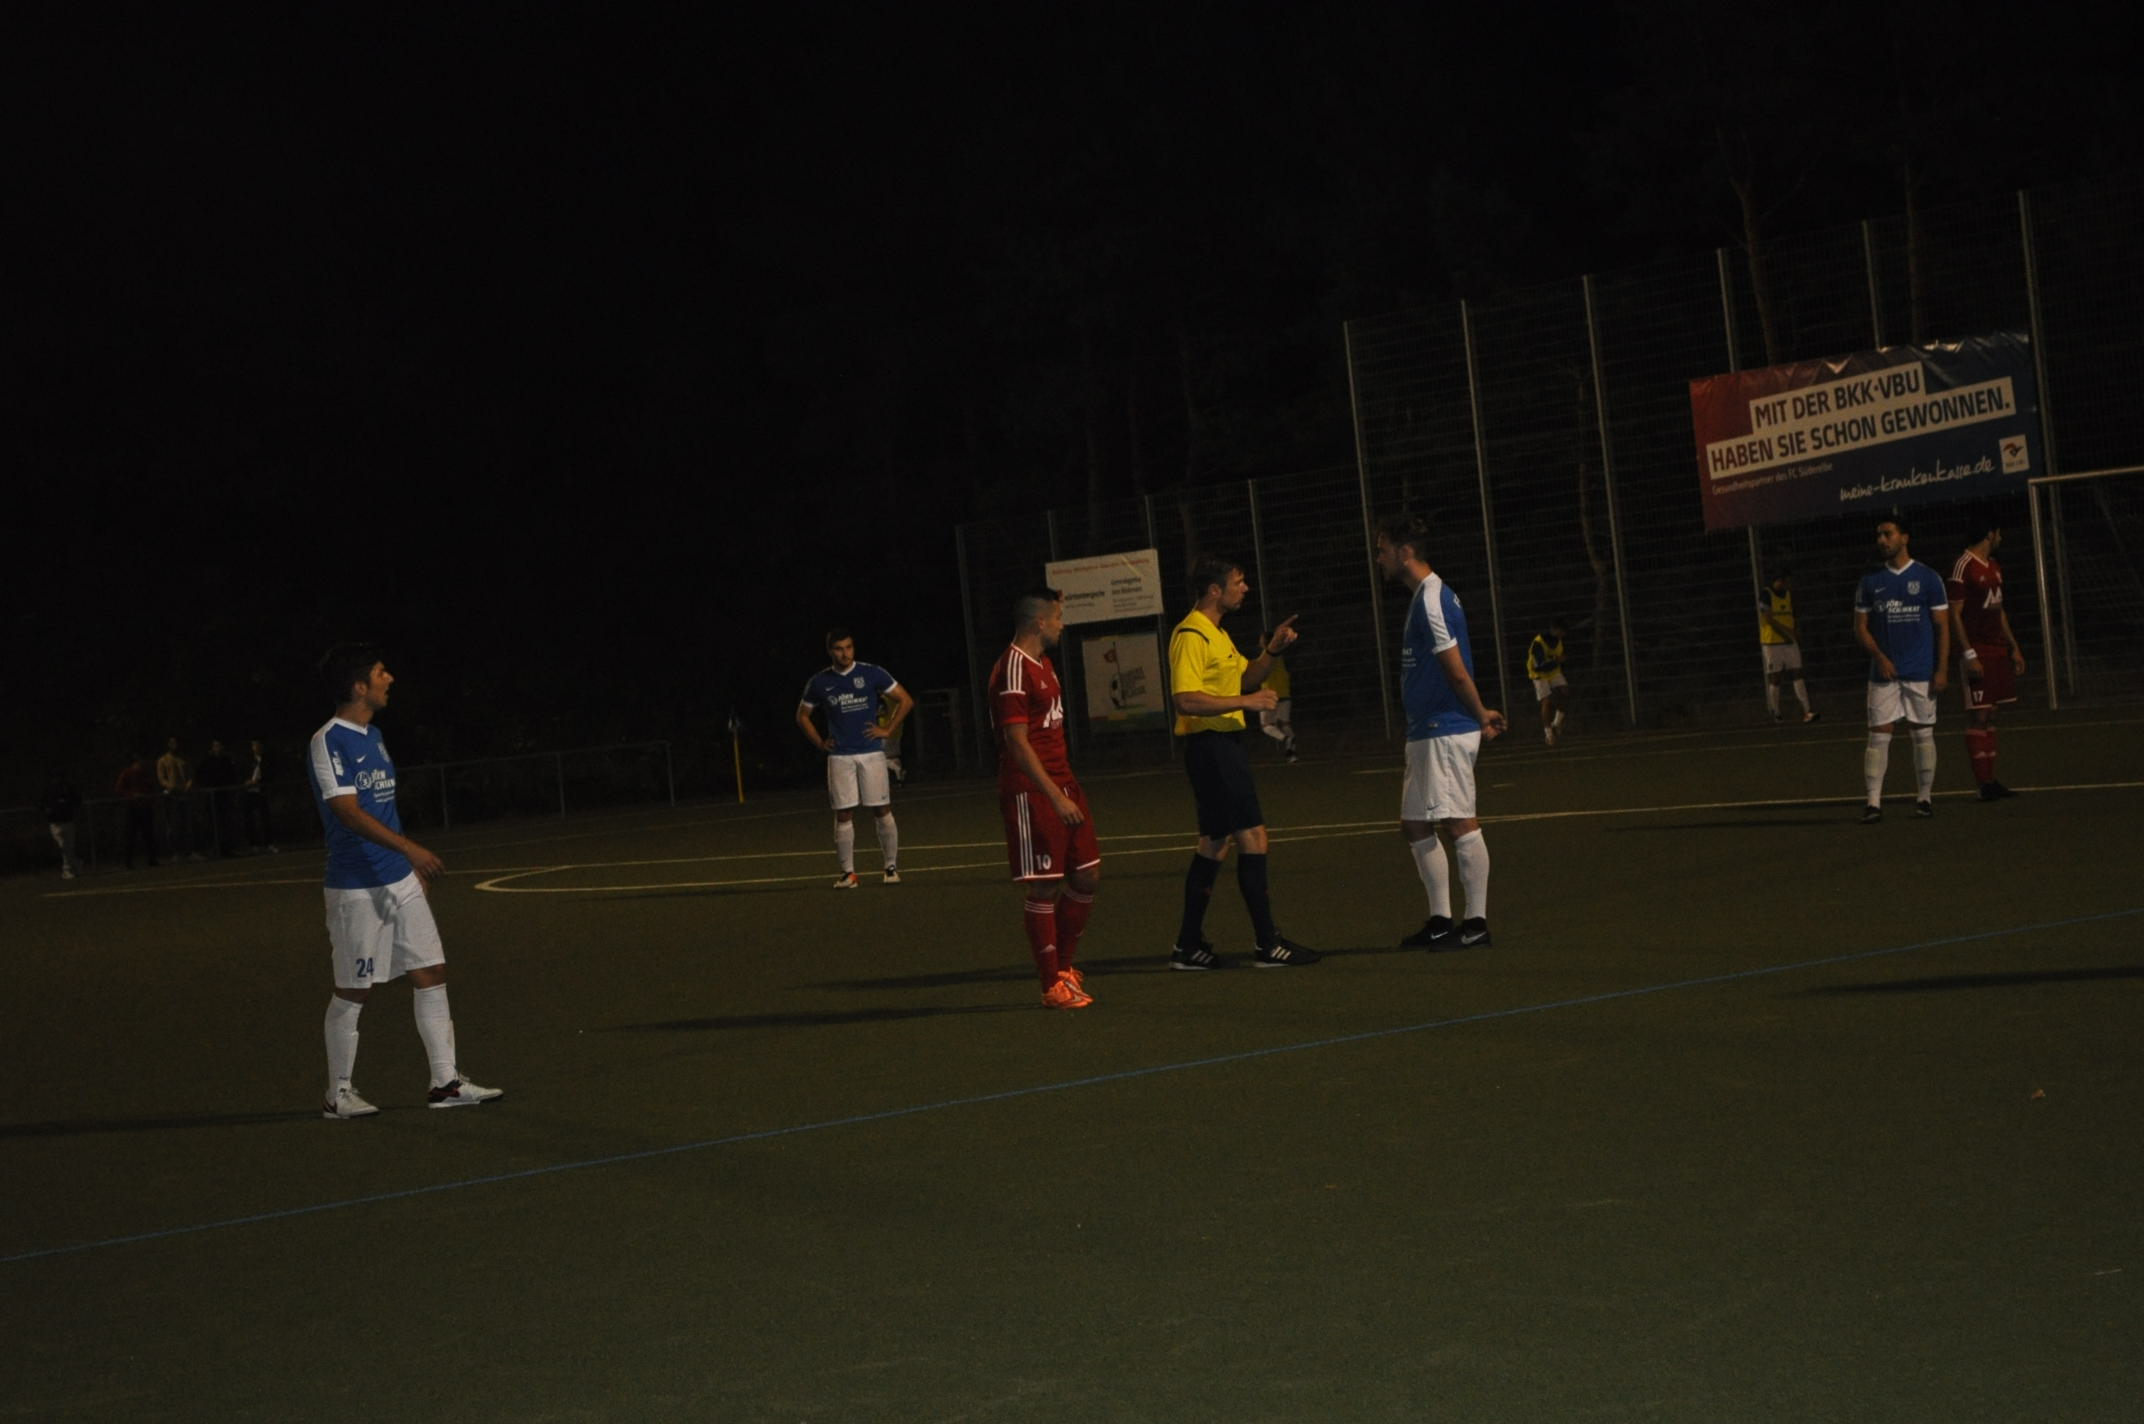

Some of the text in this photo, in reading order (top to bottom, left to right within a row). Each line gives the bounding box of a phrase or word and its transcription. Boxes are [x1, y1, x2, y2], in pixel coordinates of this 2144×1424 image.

[1754, 400, 1788, 429] MIT
[1793, 392, 1830, 420] DER
[1711, 387, 2011, 472] HABEN SIE SCHON GEWONNEN.
[1840, 455, 1996, 502] meine-krankenkasse.de
[1972, 690, 1984, 704] 17
[1035, 853, 1053, 871] 10
[355, 957, 375, 978] 24
